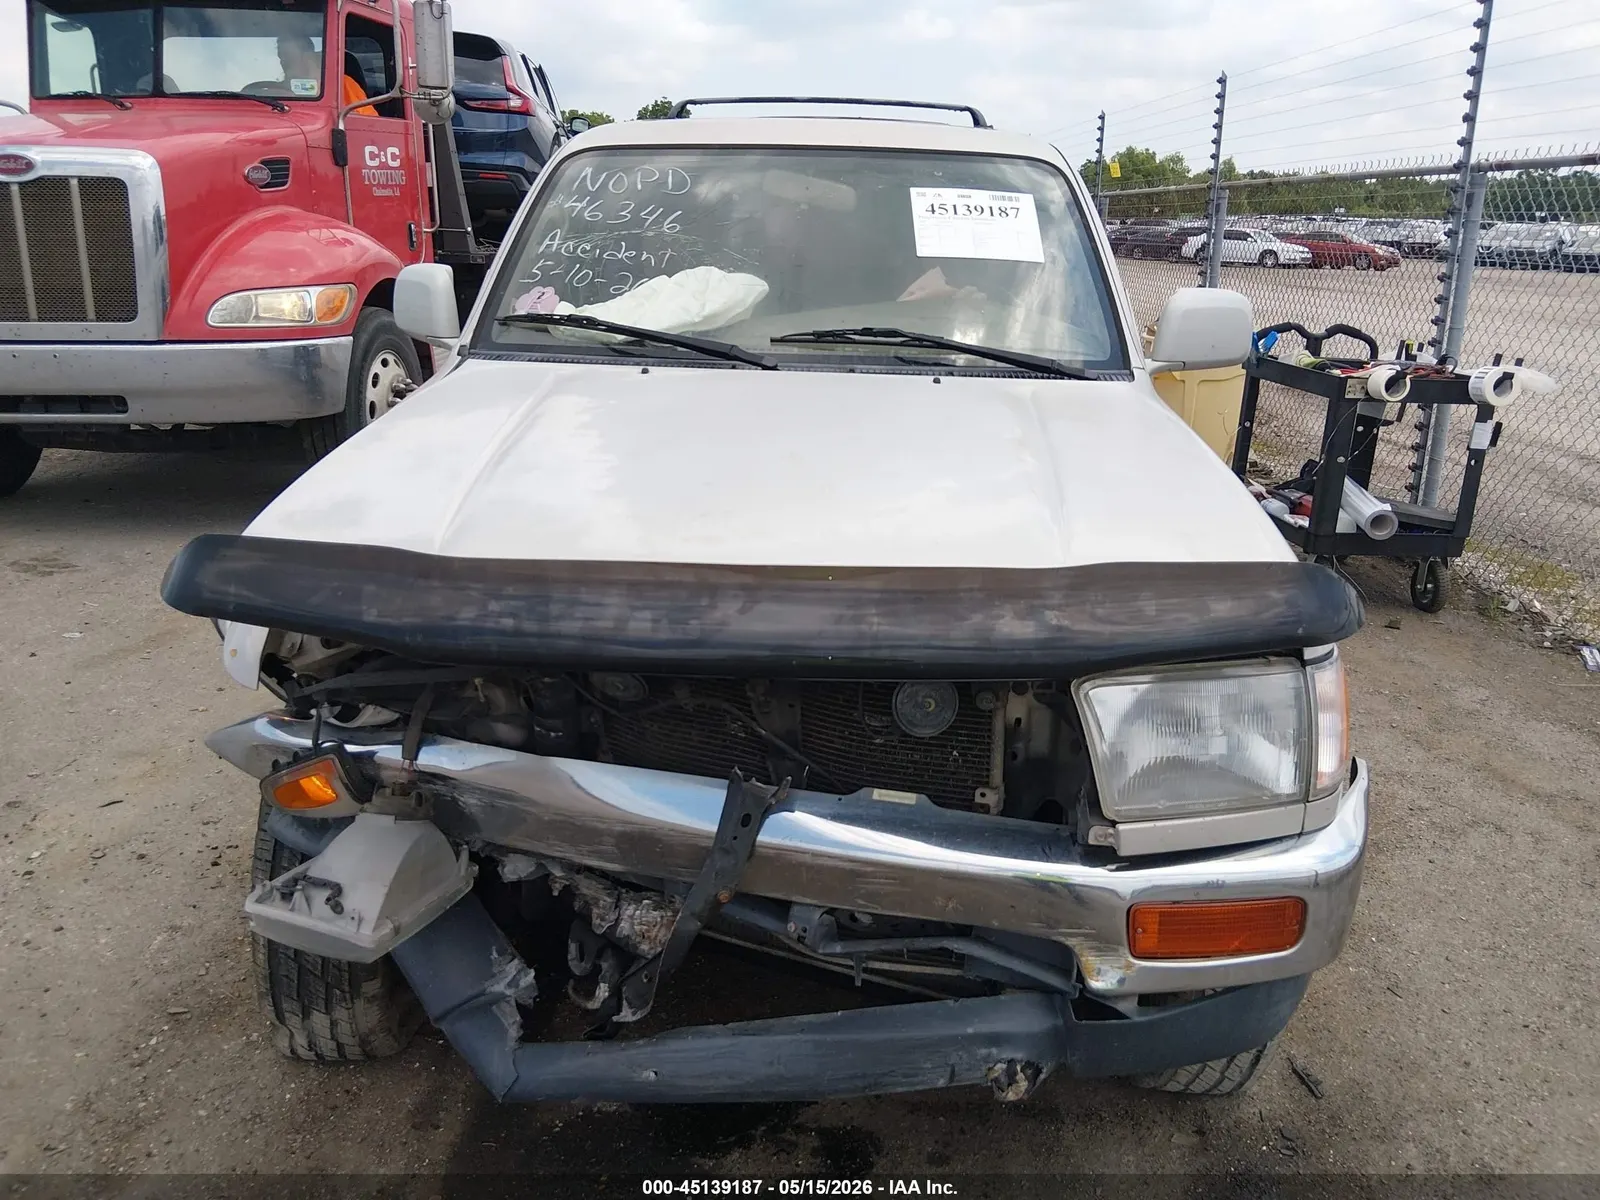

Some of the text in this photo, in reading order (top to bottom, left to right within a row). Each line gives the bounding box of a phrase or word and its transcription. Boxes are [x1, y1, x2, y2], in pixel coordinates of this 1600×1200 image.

[364, 145, 401, 167] C&C
[362, 169, 407, 185] TOWING
[572, 166, 691, 194] NOPD
[925, 202, 1020, 219] 45139187
[537, 228, 678, 269] Accident
